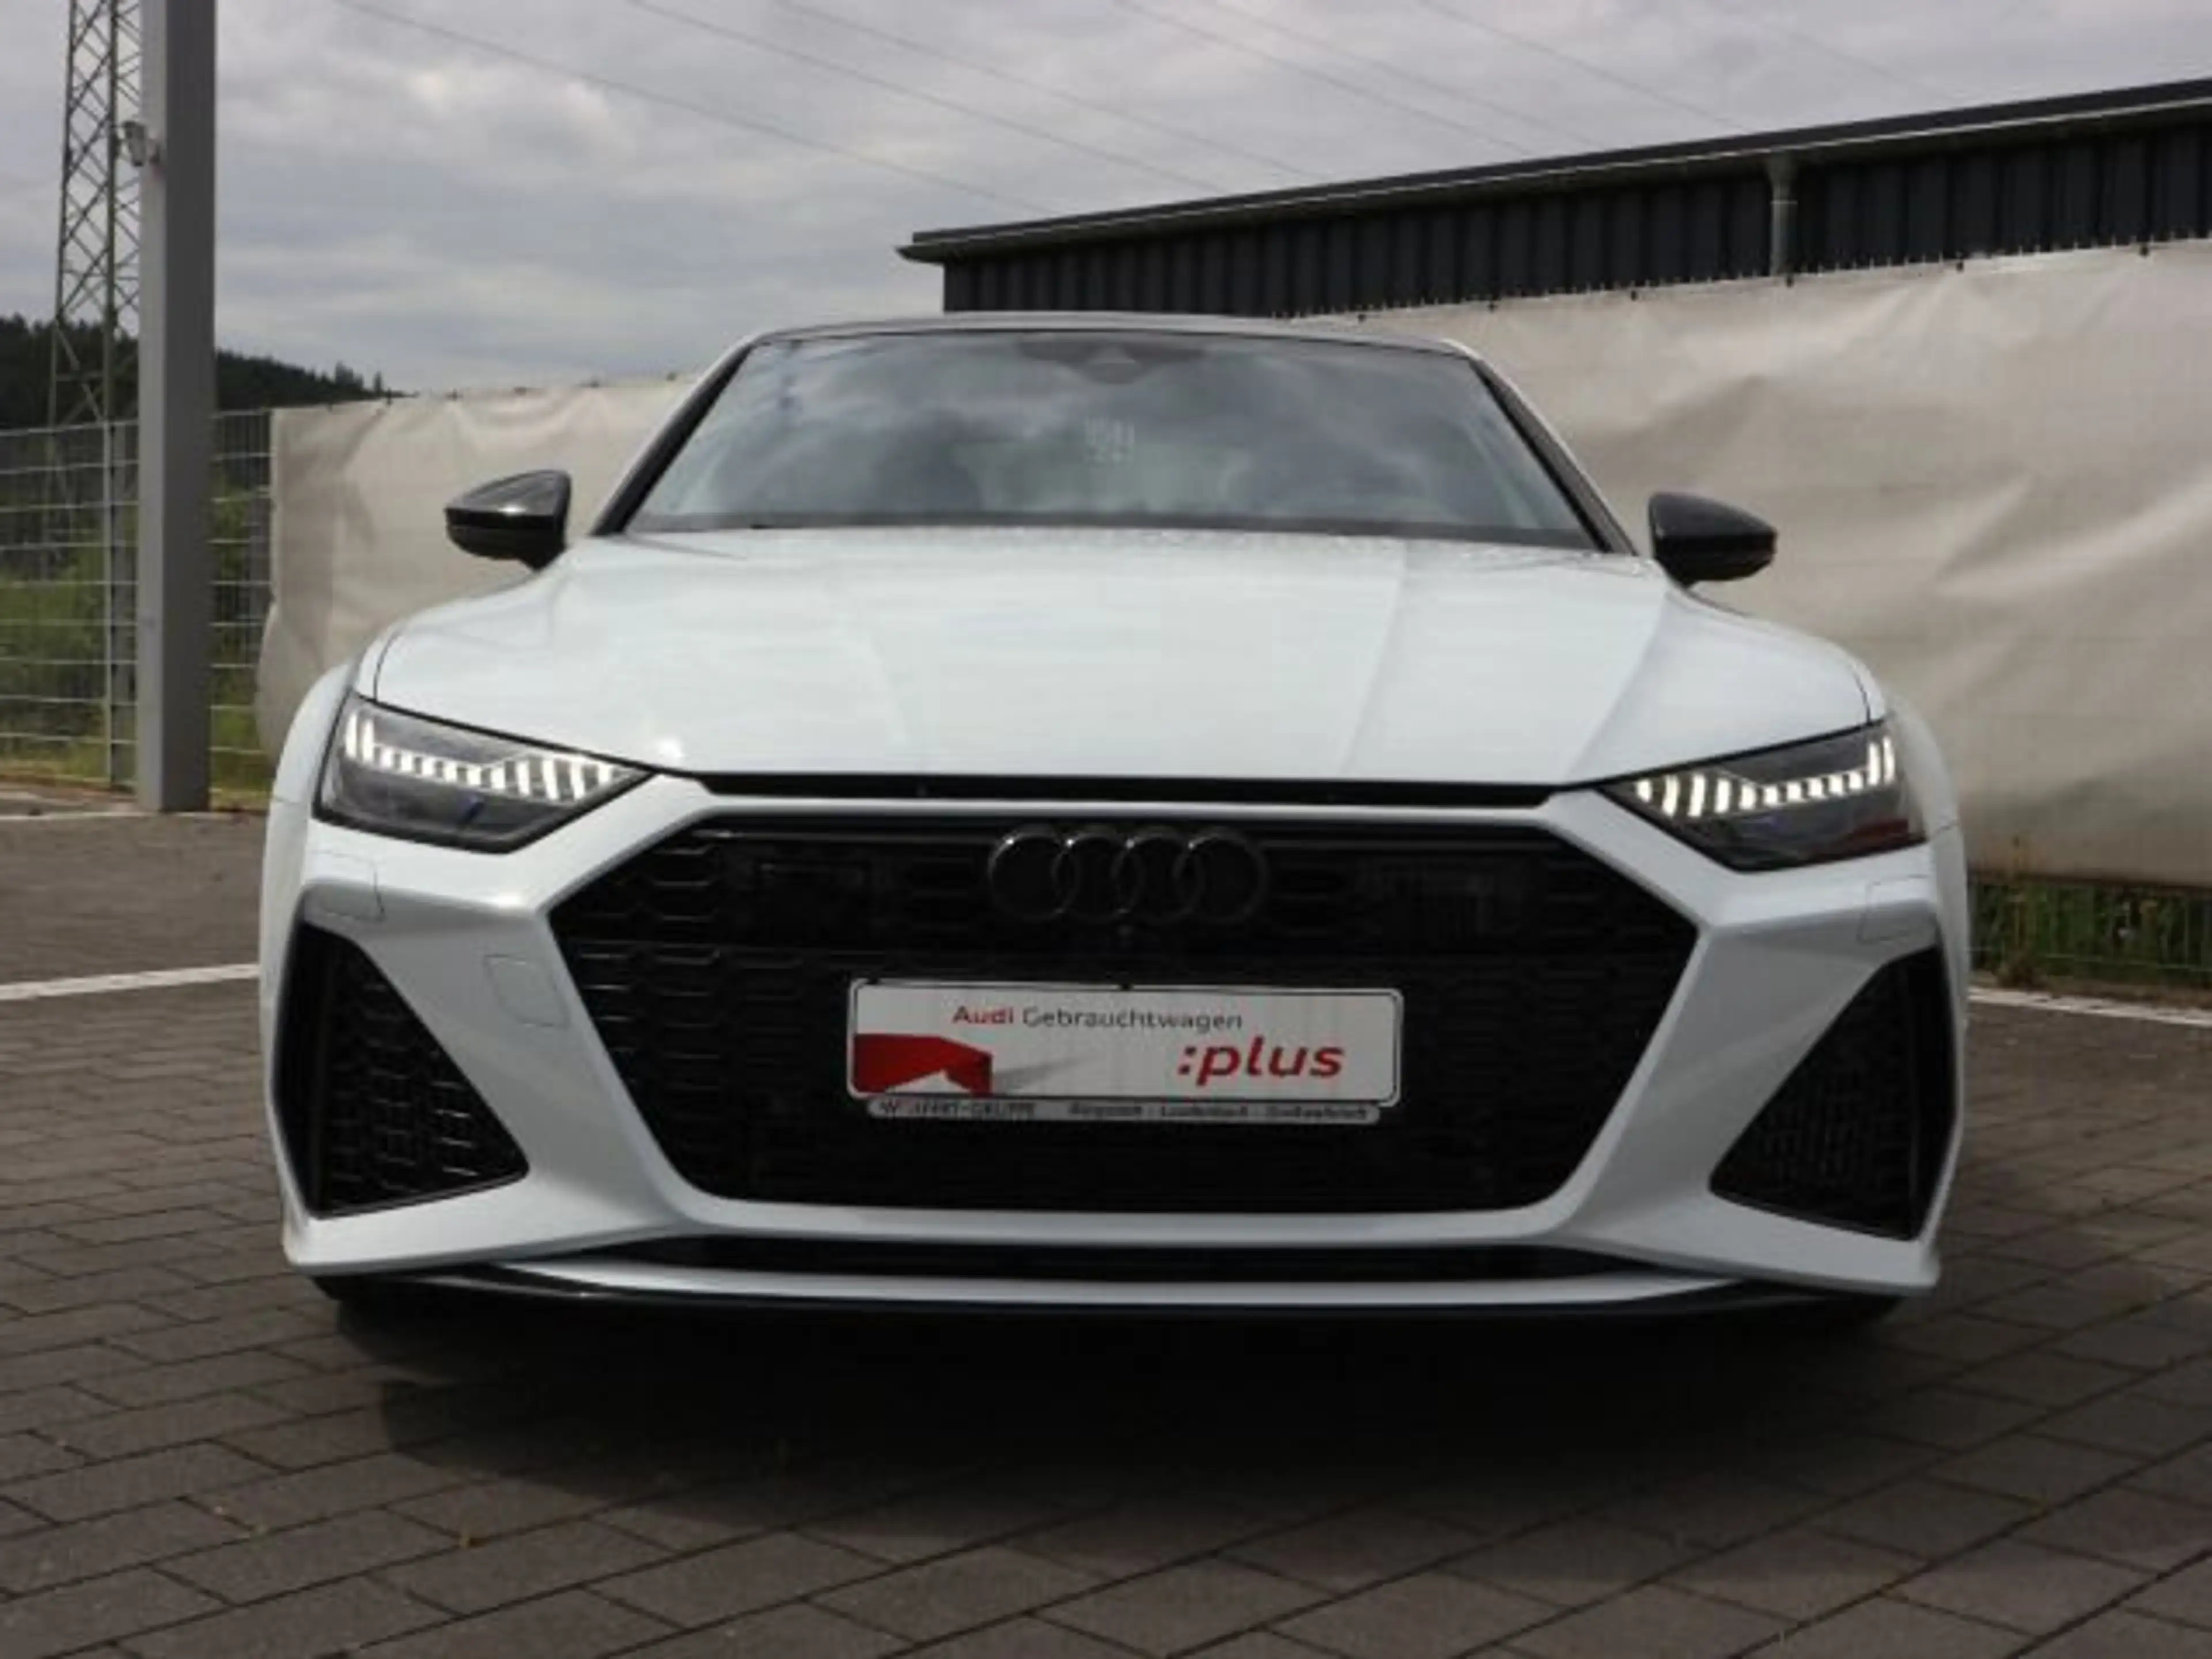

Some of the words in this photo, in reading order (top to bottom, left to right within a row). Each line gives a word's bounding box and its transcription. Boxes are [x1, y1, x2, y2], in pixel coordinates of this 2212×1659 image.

[952, 1005, 1014, 1024] Audi
[1022, 1006, 1243, 1035] Gebrauchtwagen
[1179, 1035, 1344, 1087] :plus
